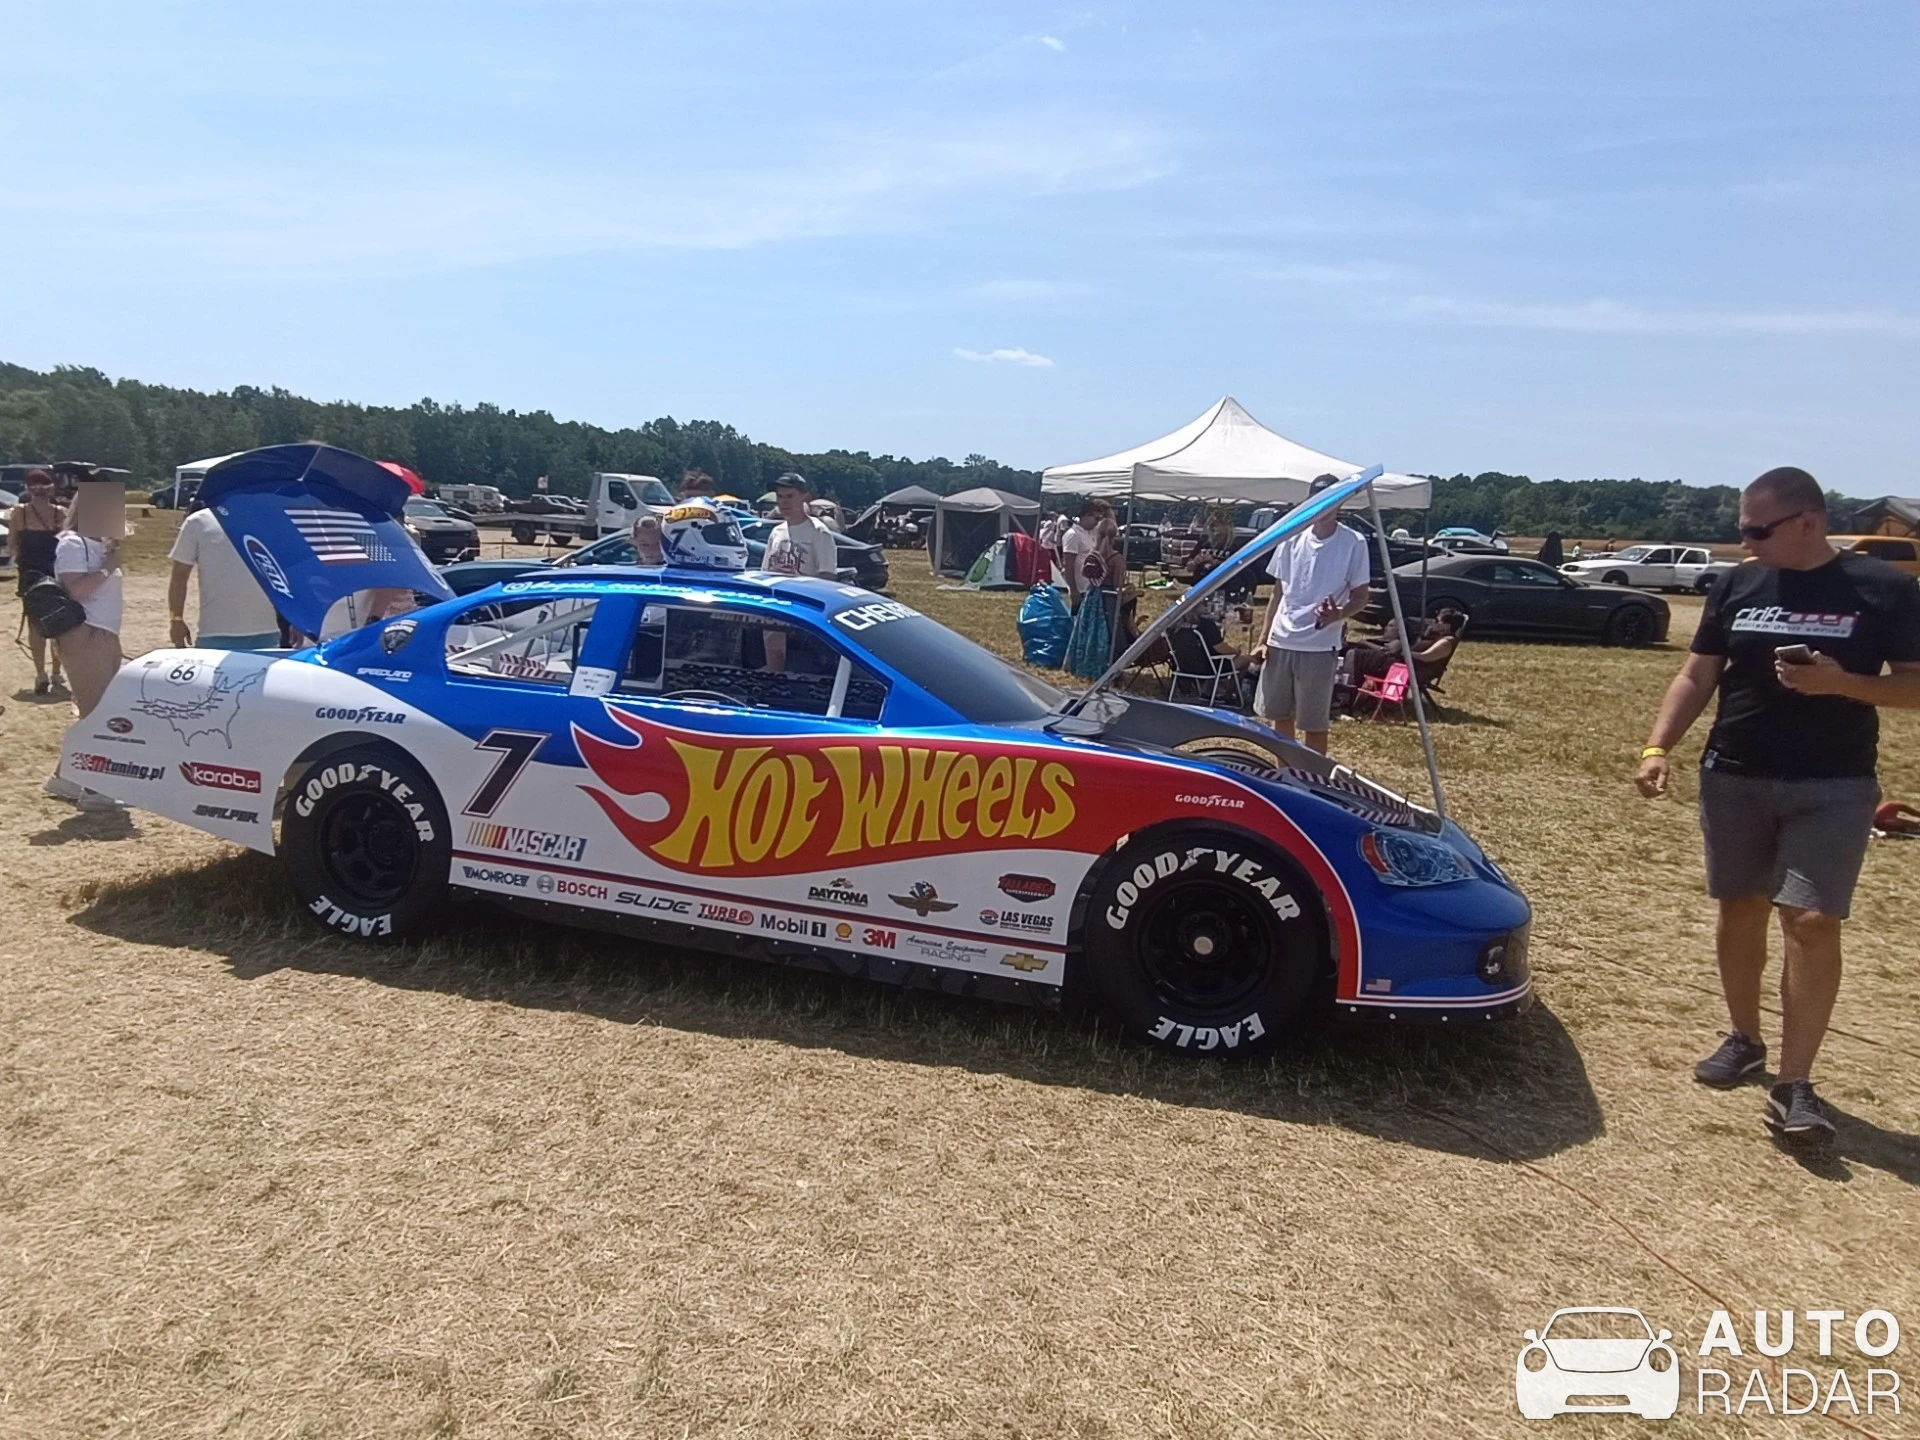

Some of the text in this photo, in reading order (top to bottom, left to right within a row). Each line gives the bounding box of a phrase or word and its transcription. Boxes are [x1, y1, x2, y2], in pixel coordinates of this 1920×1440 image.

[669, 528, 688, 551] 7
[254, 552, 294, 598] PETTY
[170, 664, 196, 681] 66
[315, 706, 407, 724] GOODYEAR
[193, 766, 259, 789] korob.pl
[460, 727, 552, 819] 7
[1175, 793, 1245, 809] GOODYEAR
[502, 826, 583, 861] NASCAR
[467, 866, 526, 886] MONROE
[557, 880, 608, 900] BOSCH
[809, 886, 868, 904] DAYTONA
[614, 891, 693, 914] SLIDE
[308, 895, 392, 937] EAGLE
[700, 903, 754, 925] TURBO
[760, 913, 808, 936] Mobil
[1000, 910, 1020, 923] LAS
[1021, 913, 1054, 928] VEGAS
[862, 928, 896, 949] 3M
[906, 934, 942, 947] American
[921, 947, 971, 962] RACING
[1148, 1012, 1266, 1050] EAGLE
